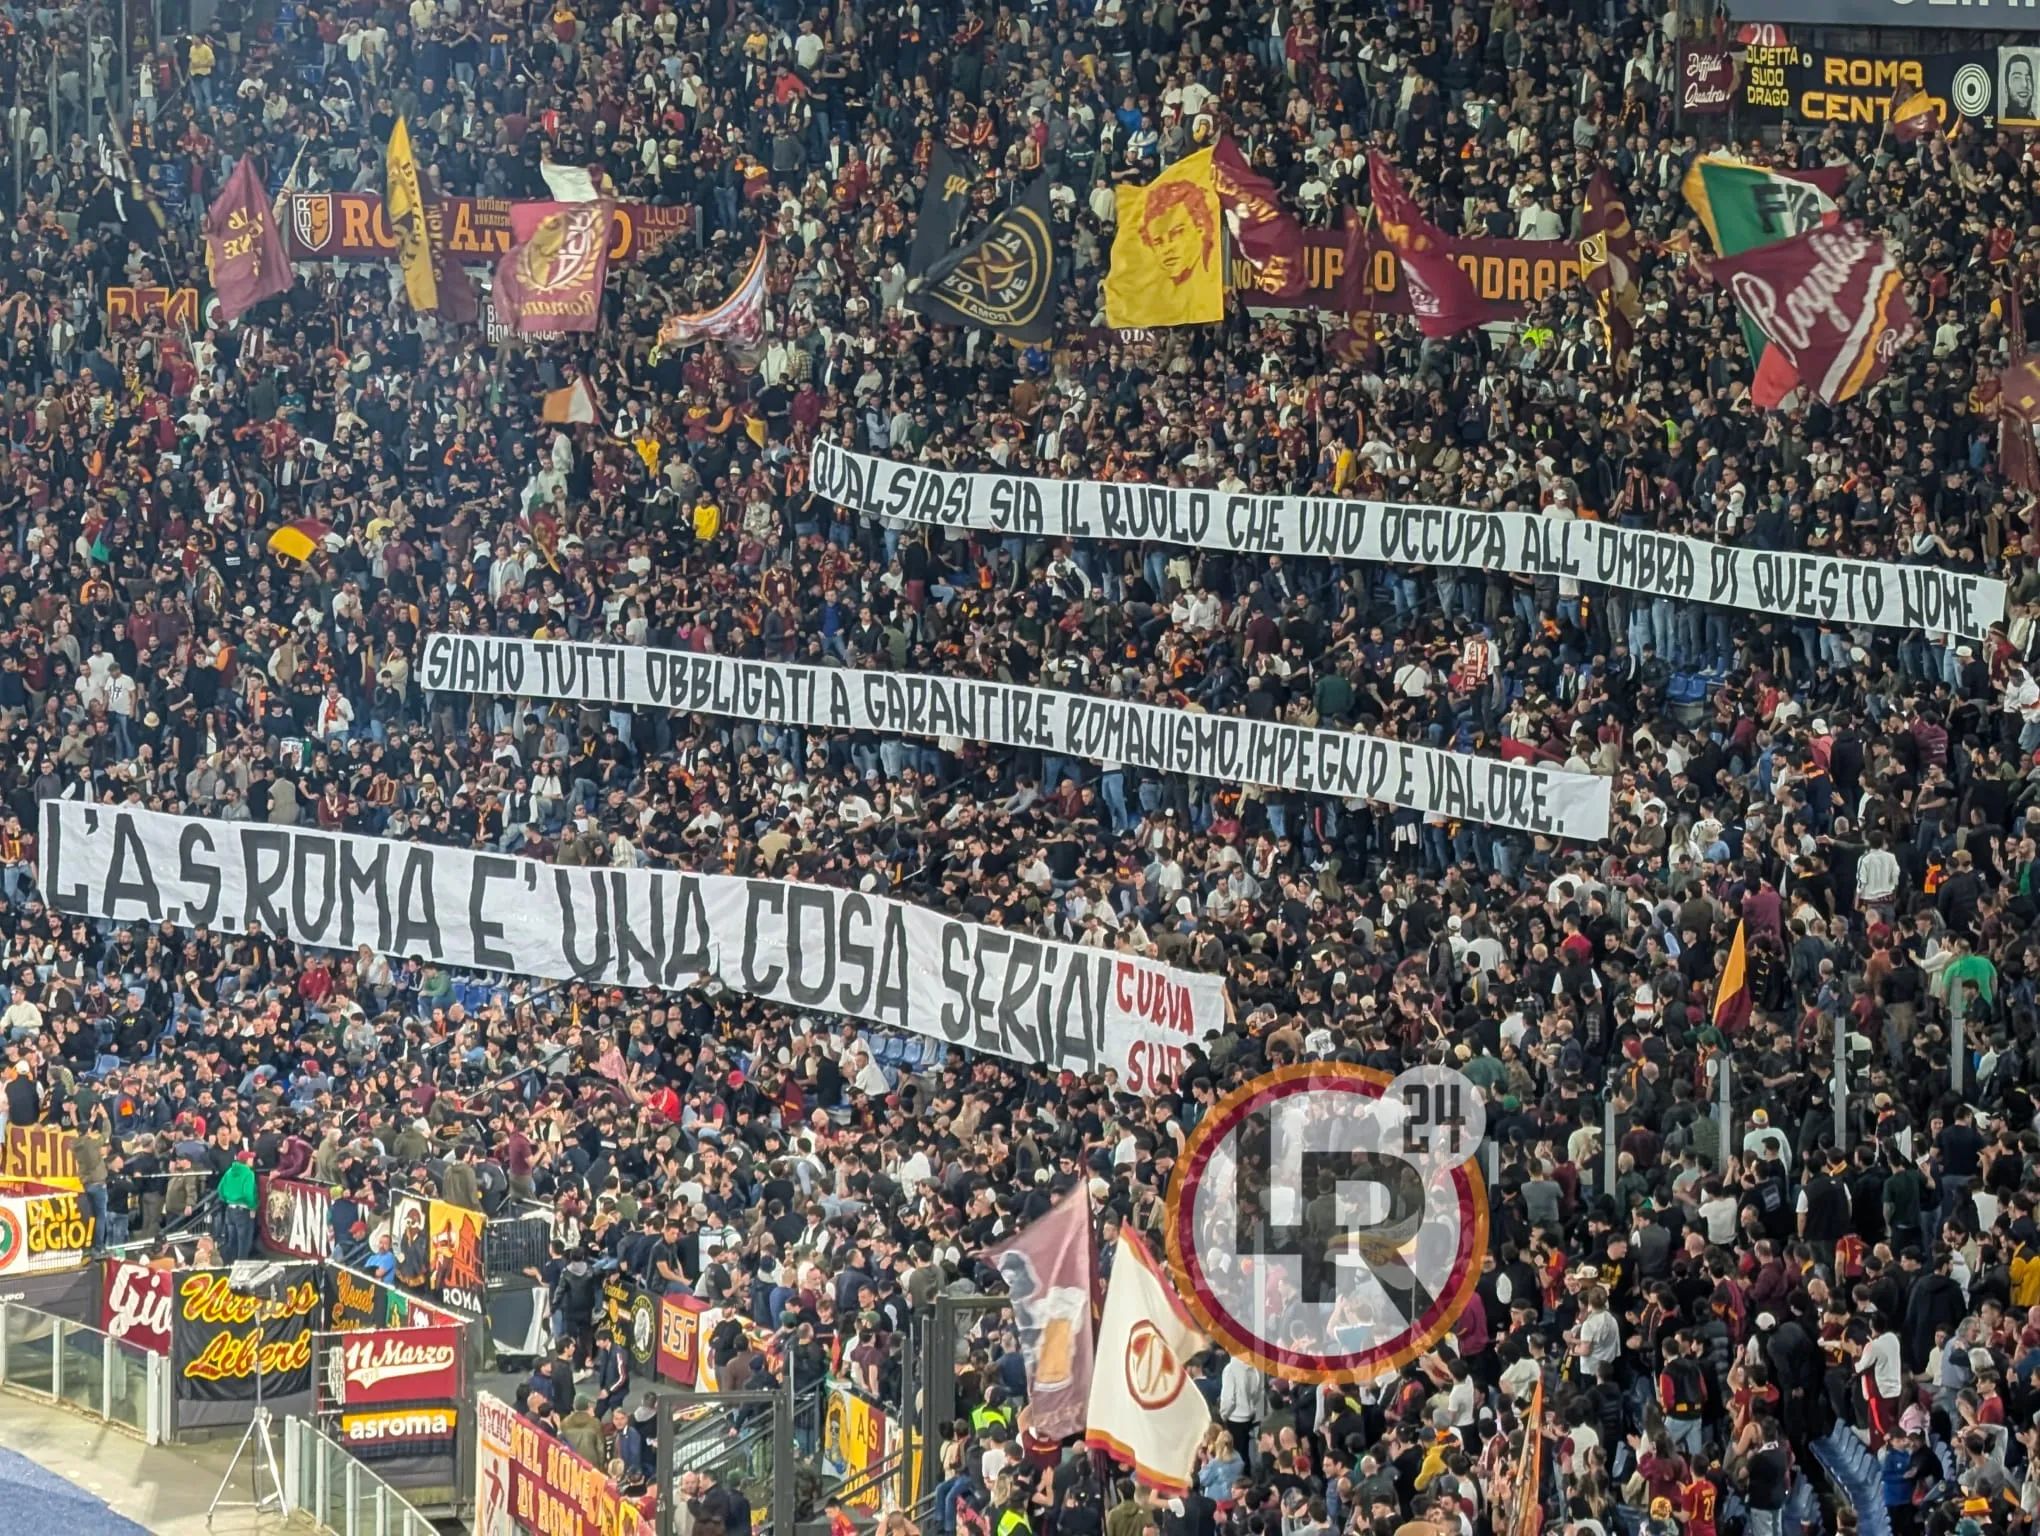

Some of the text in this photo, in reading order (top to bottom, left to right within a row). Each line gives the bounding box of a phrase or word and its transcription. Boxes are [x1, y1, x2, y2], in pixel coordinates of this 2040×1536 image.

[1751, 66, 1784, 87] SUDO
[1824, 57, 1923, 87] ROMA
[1747, 86, 1789, 106] DRAGO
[813, 440, 974, 526] QUALSIASI
[990, 478, 1044, 533] SIA
[1062, 483, 1090, 536] IL
[1099, 484, 1211, 543] RUOLO
[1226, 496, 1284, 552] CHE
[1299, 500, 1366, 558] UNO
[1380, 506, 1506, 568] OCCUPA
[1710, 546, 1739, 604] DI
[1753, 553, 1884, 622] QUESTO
[1901, 568, 1987, 639] NOME.
[427, 636, 524, 693] SIAMO
[533, 643, 626, 700] TUTTI
[646, 651, 816, 724] OBBLIGATI
[830, 671, 851, 726] A
[863, 673, 1056, 749] GARANTIRE
[1395, 747, 1415, 806] E
[1424, 751, 1564, 833] VALORE.
[469, 855, 537, 970] E'
[554, 869, 711, 986] UNA
[741, 880, 909, 1027] COSA
[1117, 961, 1194, 1036] CURVA
[27, 1193, 81, 1226] DAJE
[29, 1217, 95, 1252] GIGIO!
[184, 1328, 312, 1381] Liberi
[346, 1338, 455, 1371] 11 Marzo
[350, 1413, 447, 1441] asroma
[517, 1473, 535, 1522] DI
